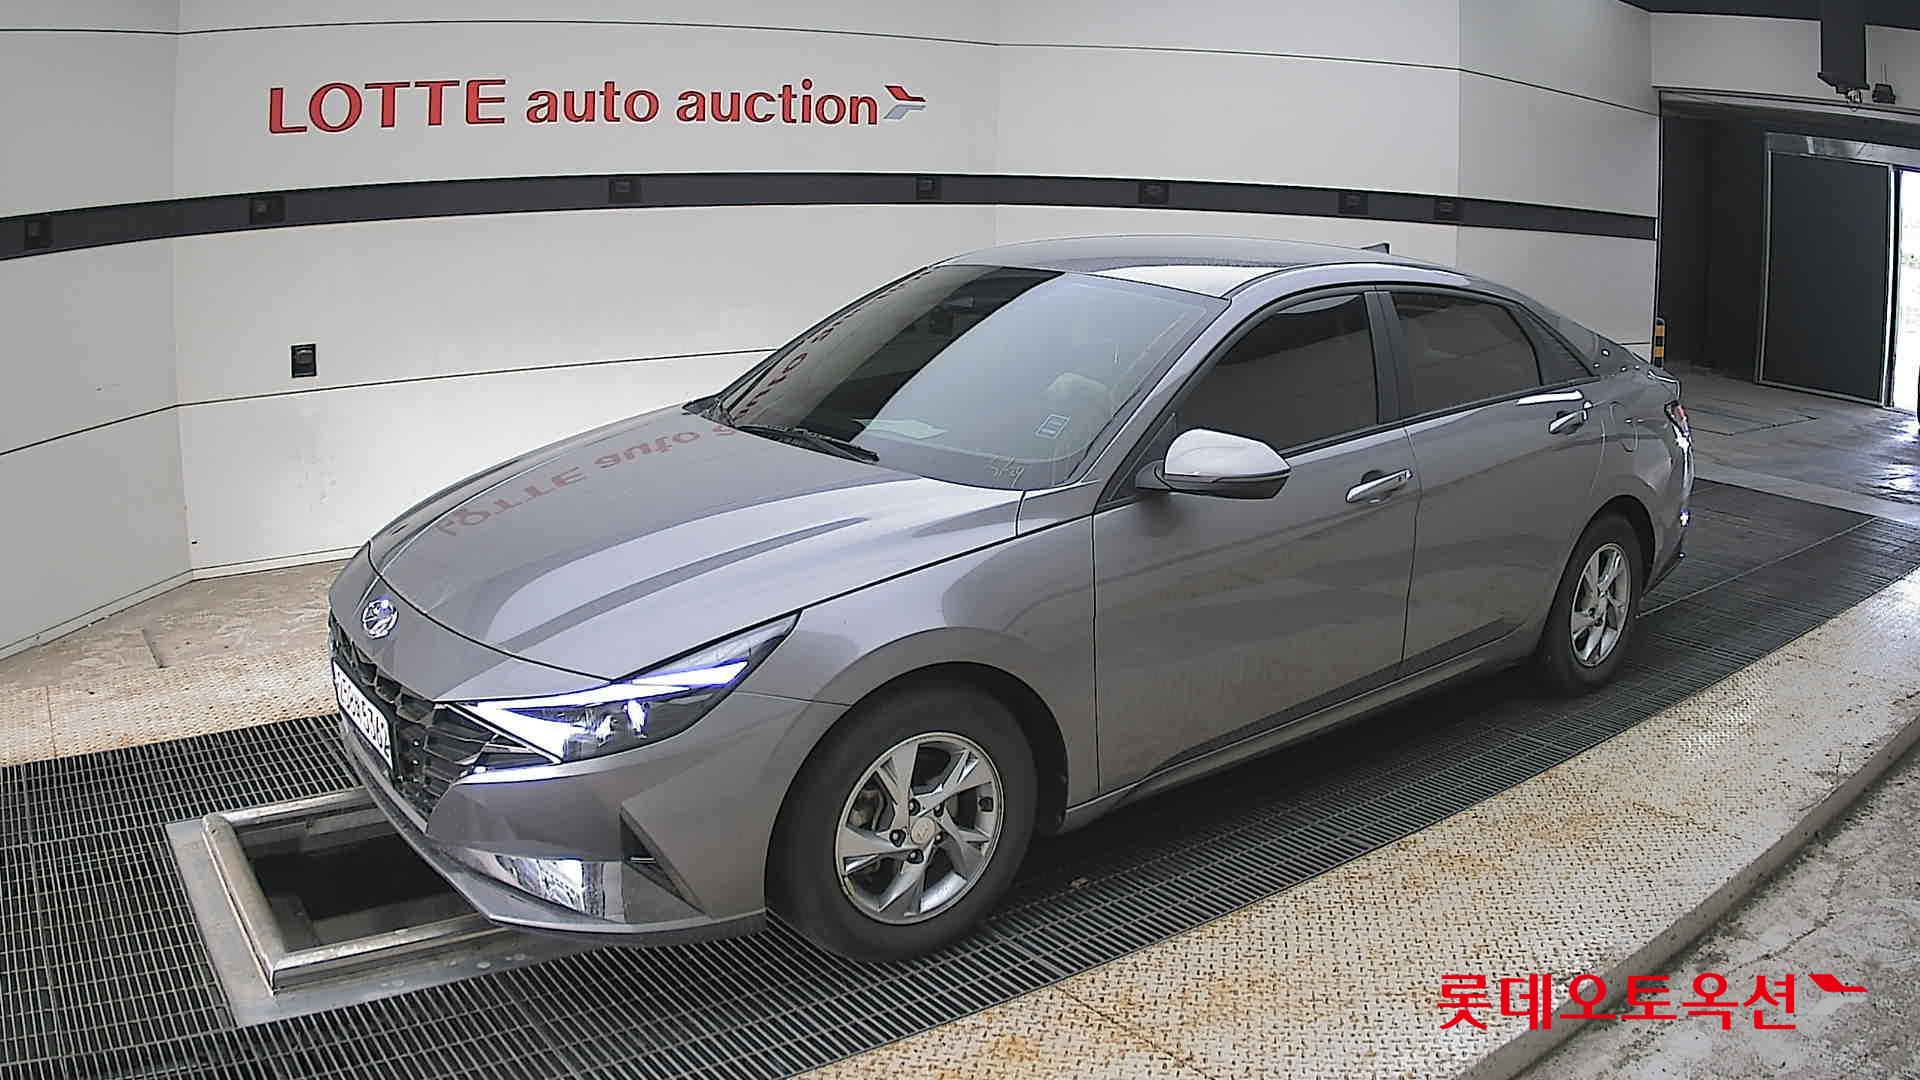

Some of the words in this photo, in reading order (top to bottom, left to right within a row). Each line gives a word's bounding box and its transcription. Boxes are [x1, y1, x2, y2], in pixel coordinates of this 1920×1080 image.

[269, 79, 506, 134] LOTTE
[526, 80, 660, 123] auto
[676, 78, 878, 125] auction
